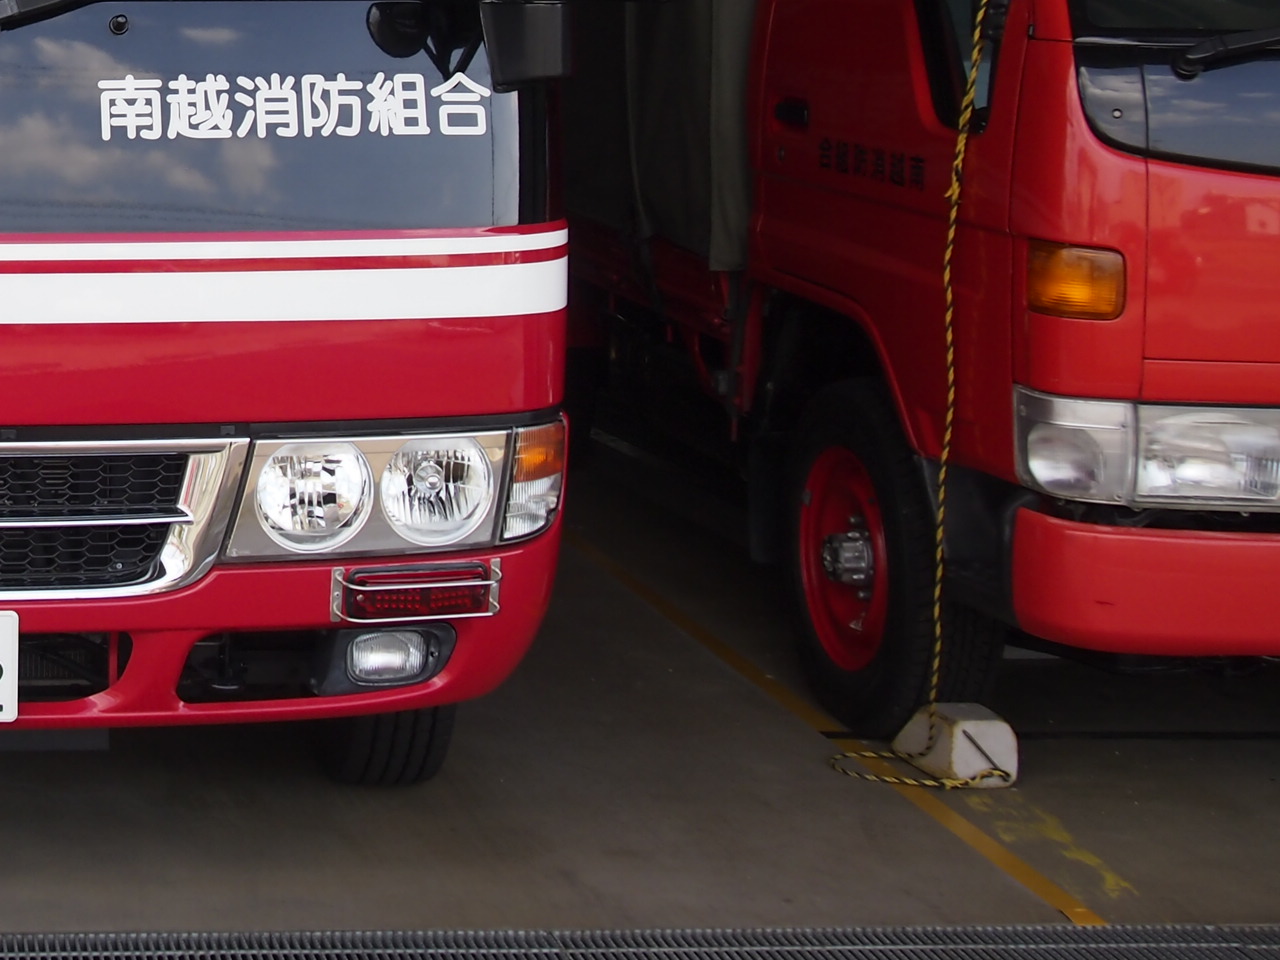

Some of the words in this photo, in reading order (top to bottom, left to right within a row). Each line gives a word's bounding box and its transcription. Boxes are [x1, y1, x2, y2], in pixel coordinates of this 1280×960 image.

[97, 71, 492, 141] 南越消防組合
